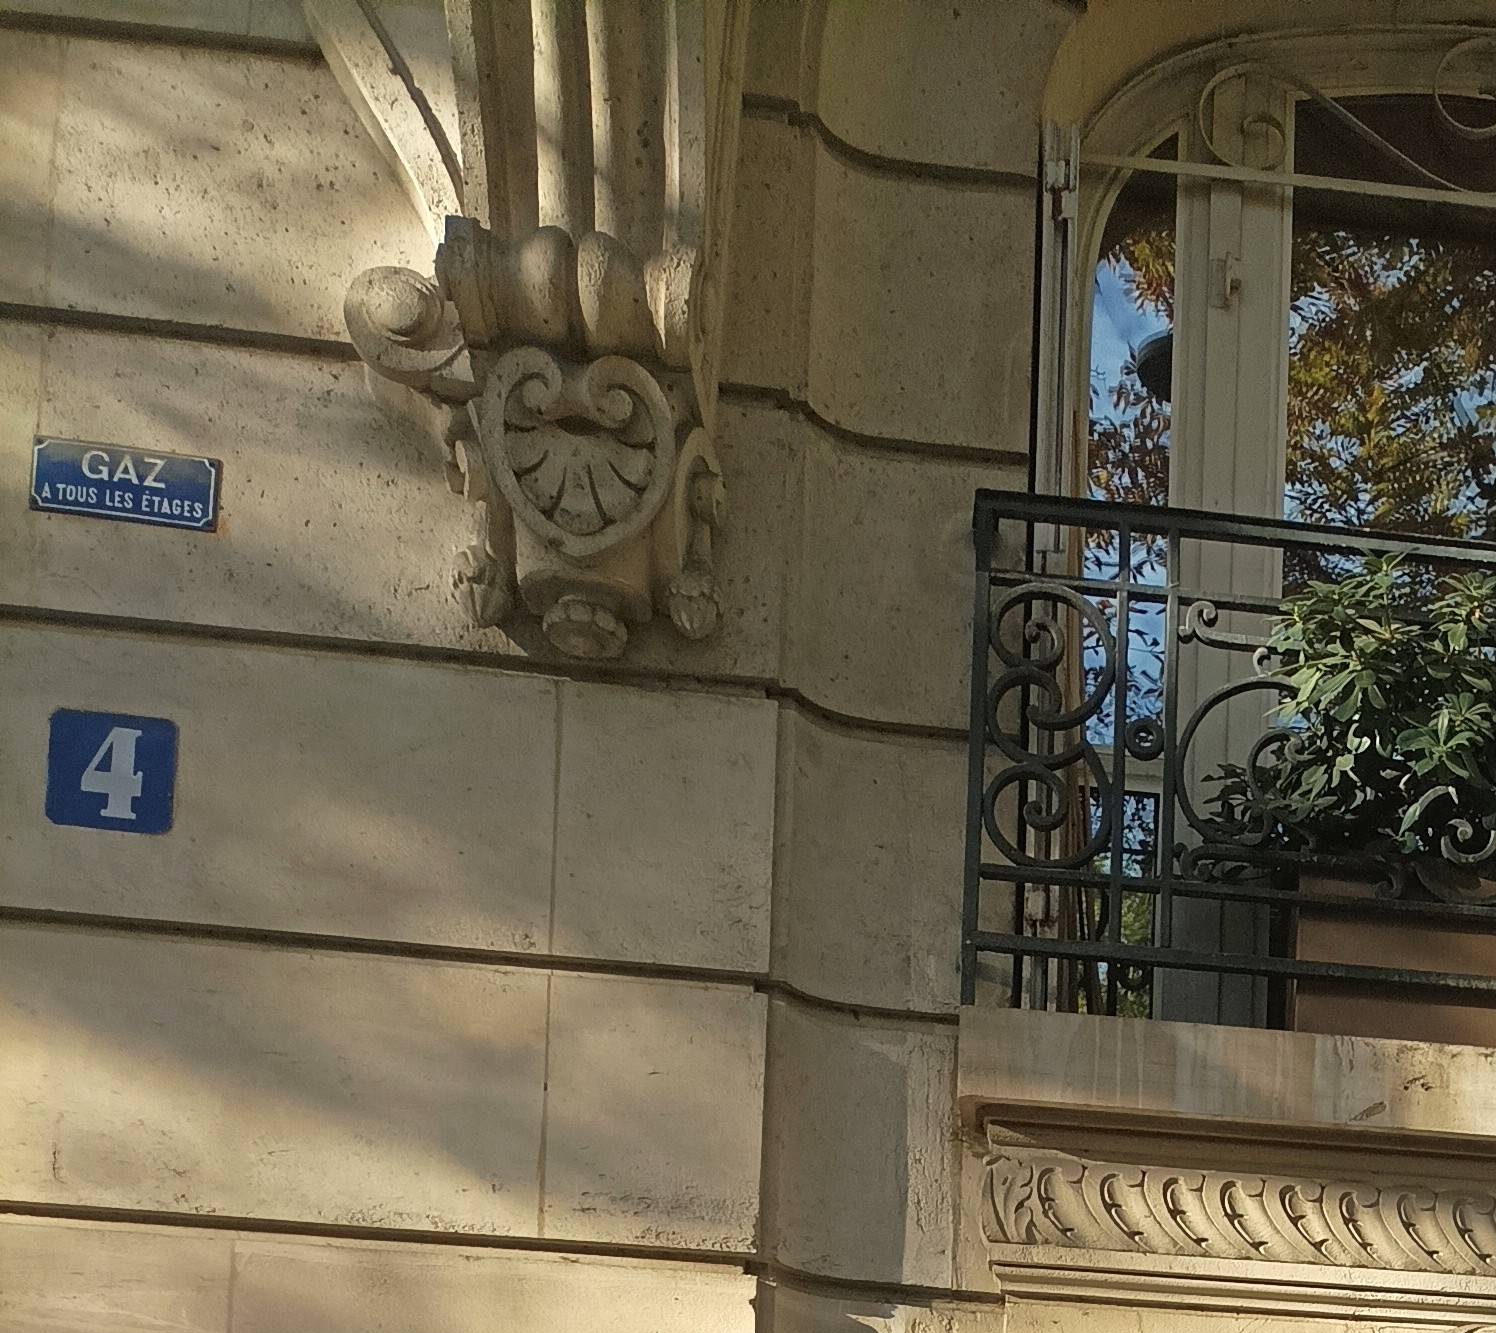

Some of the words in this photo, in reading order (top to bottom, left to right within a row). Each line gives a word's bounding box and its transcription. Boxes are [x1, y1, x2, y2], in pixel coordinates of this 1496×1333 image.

[81, 450, 168, 489] GAZ
[41, 482, 51, 499] A
[56, 483, 98, 504] TOUS
[105, 488, 134, 509] LES
[141, 490, 204, 518] ÉTAGES
[80, 726, 143, 820] 4
